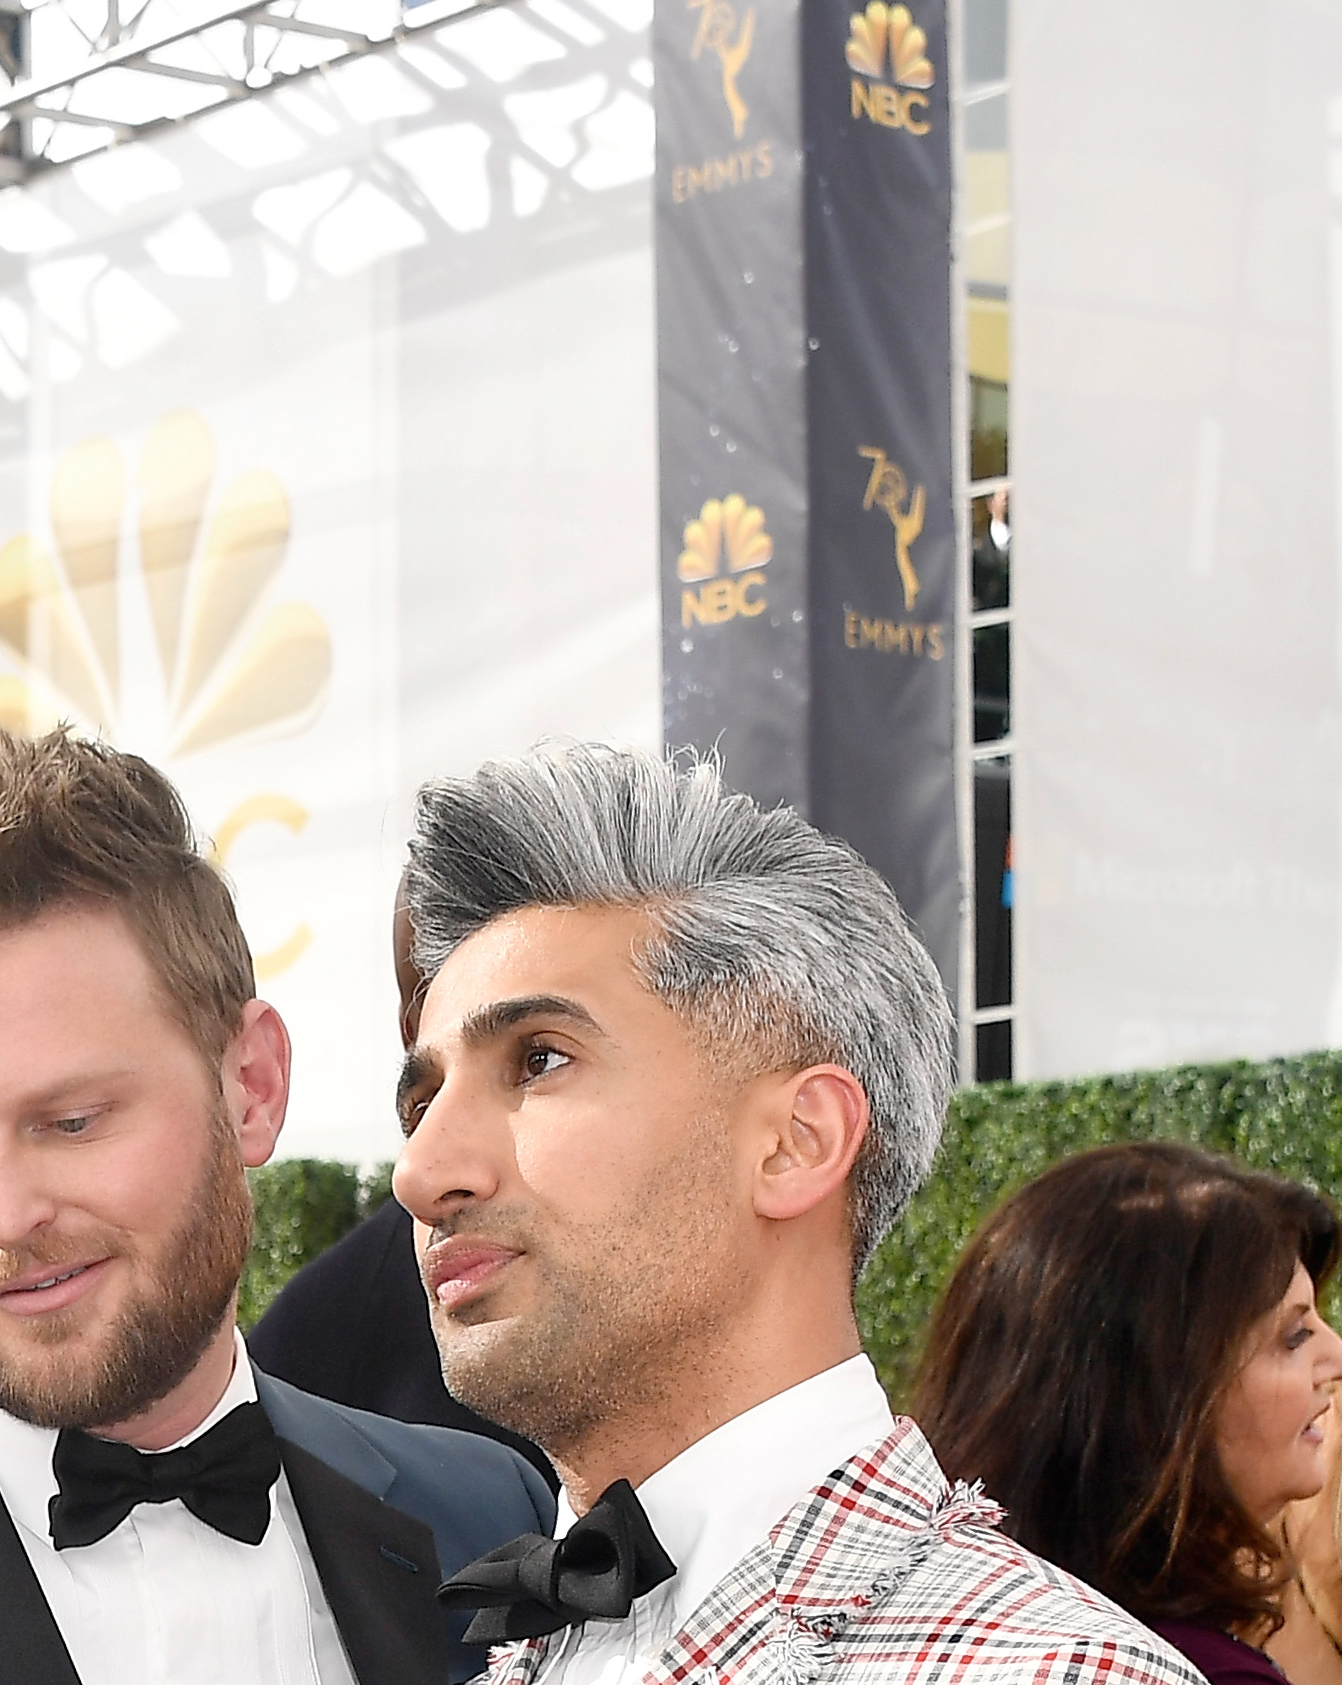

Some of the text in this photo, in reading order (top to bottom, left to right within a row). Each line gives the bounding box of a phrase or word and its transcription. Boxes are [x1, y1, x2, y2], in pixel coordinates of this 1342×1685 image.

[850, 78, 931, 136] NBC
[672, 140, 774, 203] EMMYS
[680, 571, 767, 630] NBC
[844, 611, 945, 660] EMMYS
